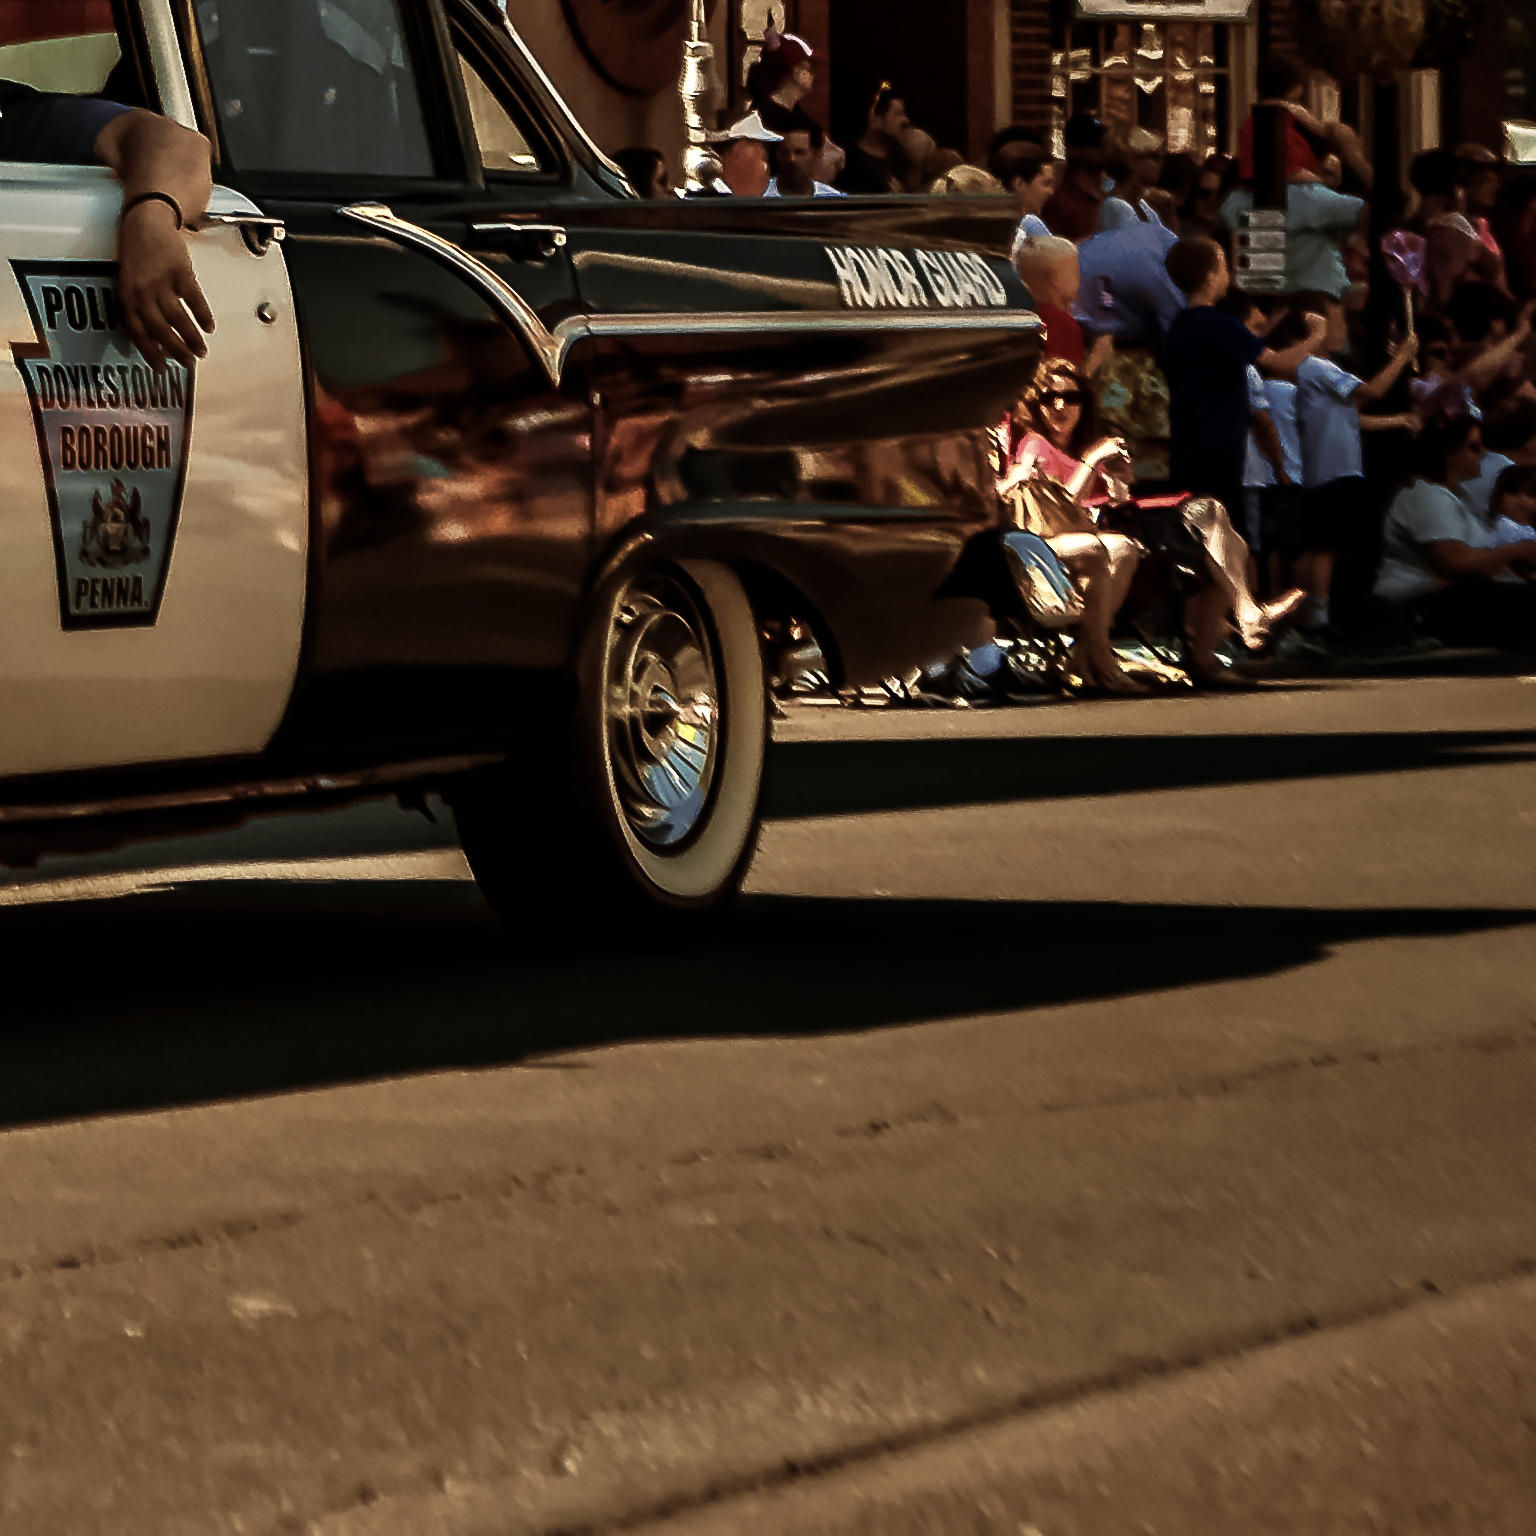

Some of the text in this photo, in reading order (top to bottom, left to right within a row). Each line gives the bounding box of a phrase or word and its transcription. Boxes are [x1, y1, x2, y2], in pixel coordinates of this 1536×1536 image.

[823, 246, 1007, 308] HONOR GUARD
[41, 285, 117, 332] POLI
[35, 363, 186, 410] DOYLESTOWN
[60, 424, 172, 472] BOROUGH
[74, 576, 150, 611] PENNA.
